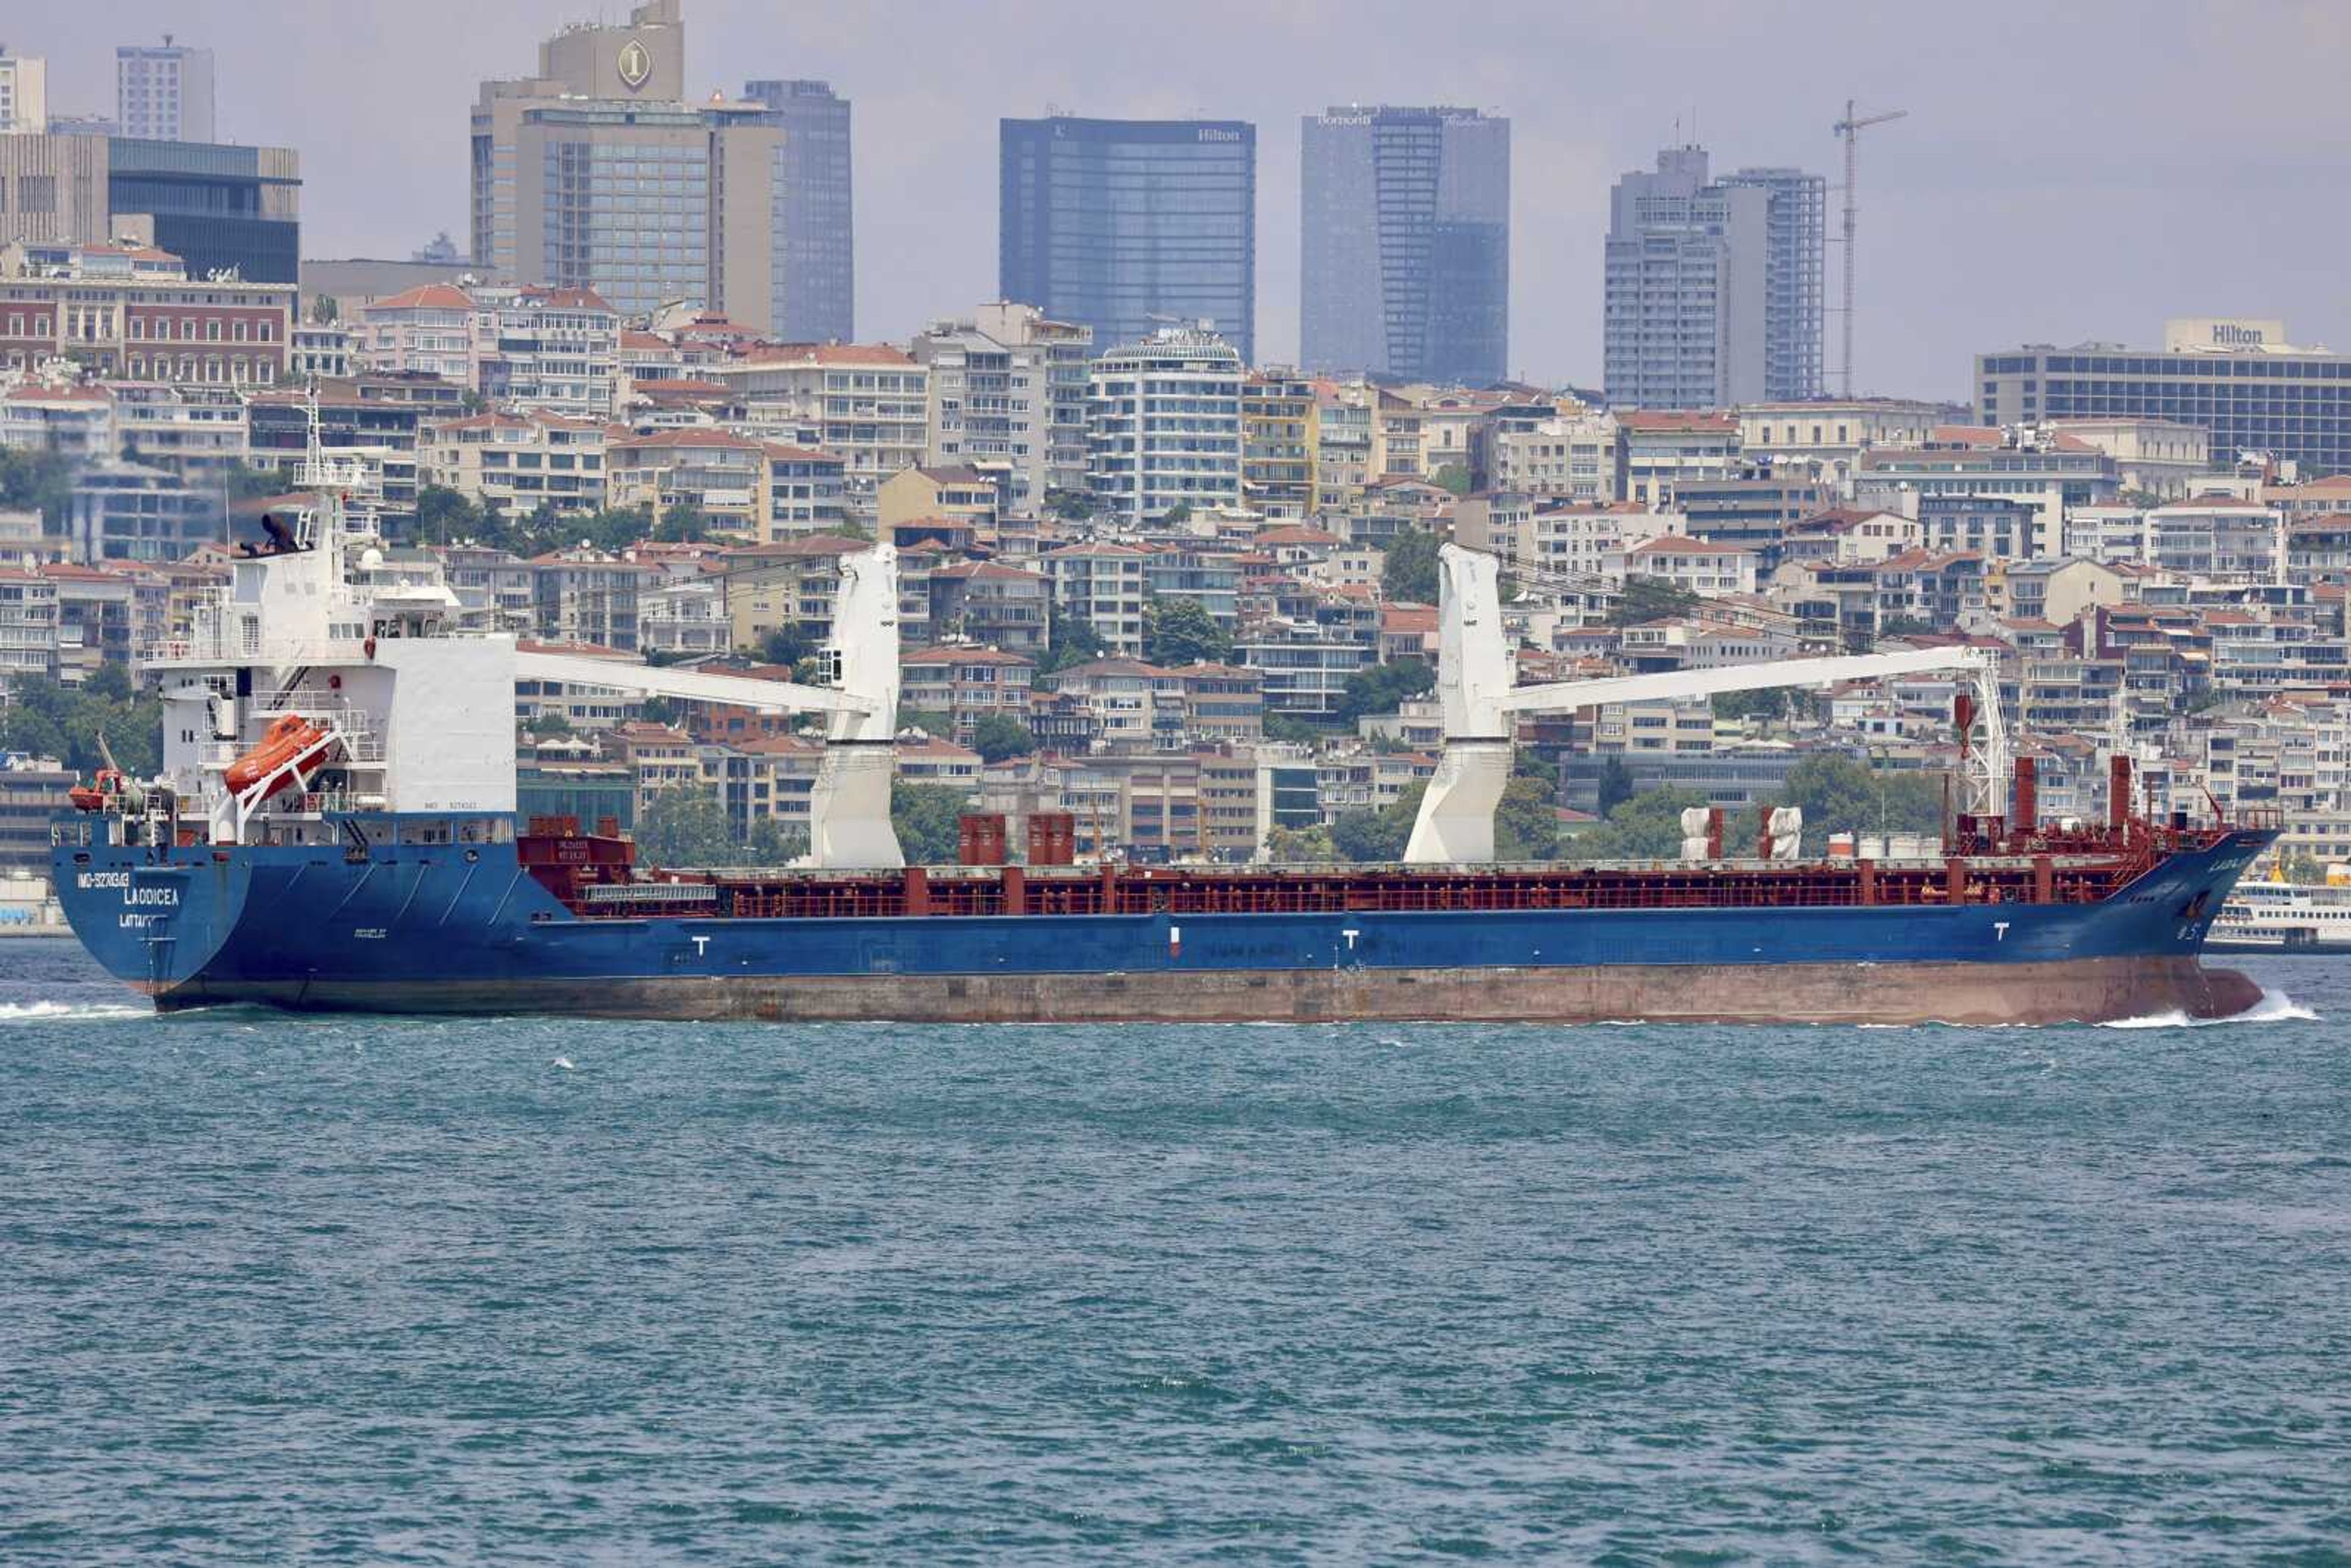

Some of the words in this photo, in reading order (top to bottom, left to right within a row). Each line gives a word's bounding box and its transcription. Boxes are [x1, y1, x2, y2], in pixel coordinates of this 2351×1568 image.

[1199, 129, 1240, 142] Hilton
[2213, 324, 2263, 343] Hilton
[124, 888, 179, 906] LAODICEA
